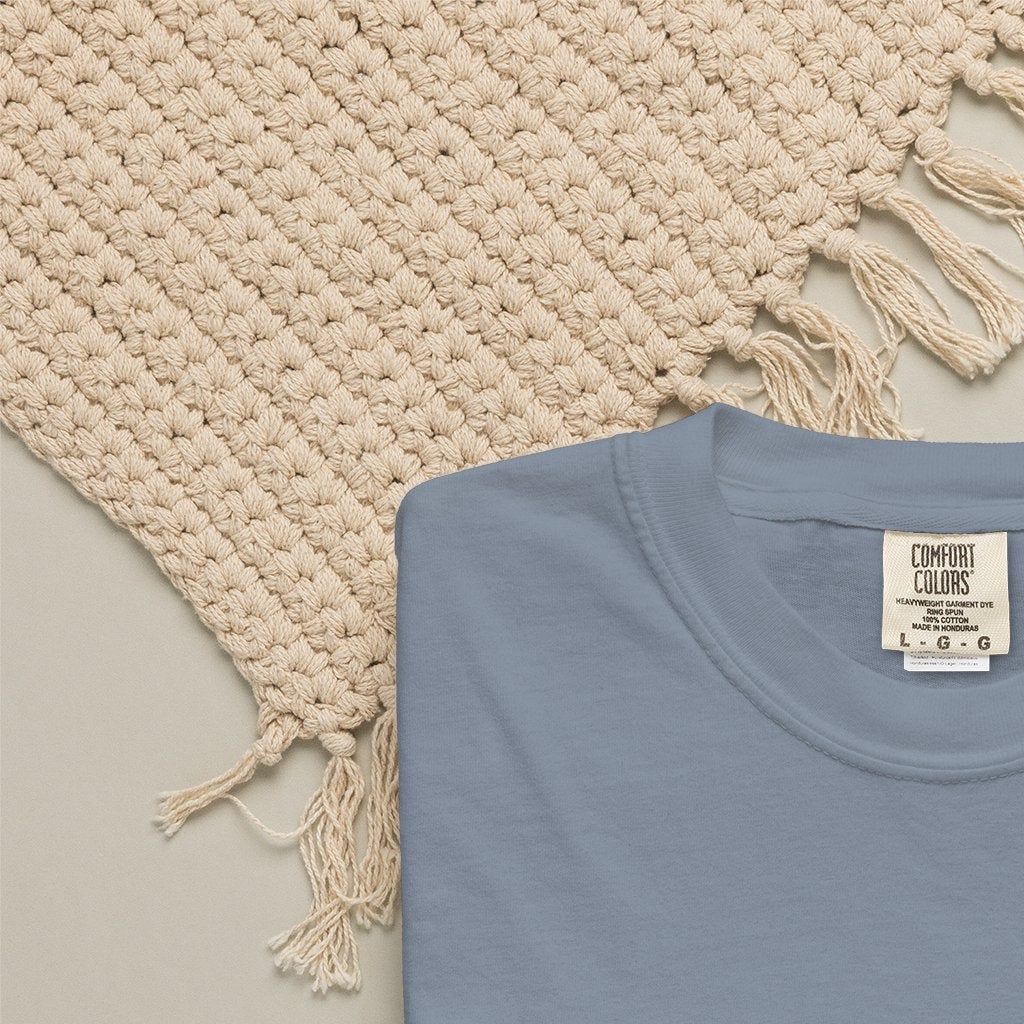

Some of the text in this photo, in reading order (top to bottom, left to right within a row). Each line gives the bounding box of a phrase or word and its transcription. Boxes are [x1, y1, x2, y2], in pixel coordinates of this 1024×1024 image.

[911, 543, 975, 568] COMFORT
[895, 598, 994, 609] HEAVYWEIGHT GARMENT DYE
[927, 608, 964, 616] RING SPUN
[922, 616, 969, 624] 100% COTTON
[912, 623, 931, 631] MADE
[900, 632, 910, 647] L
[937, 635, 950, 650] G
[977, 636, 991, 650] G
